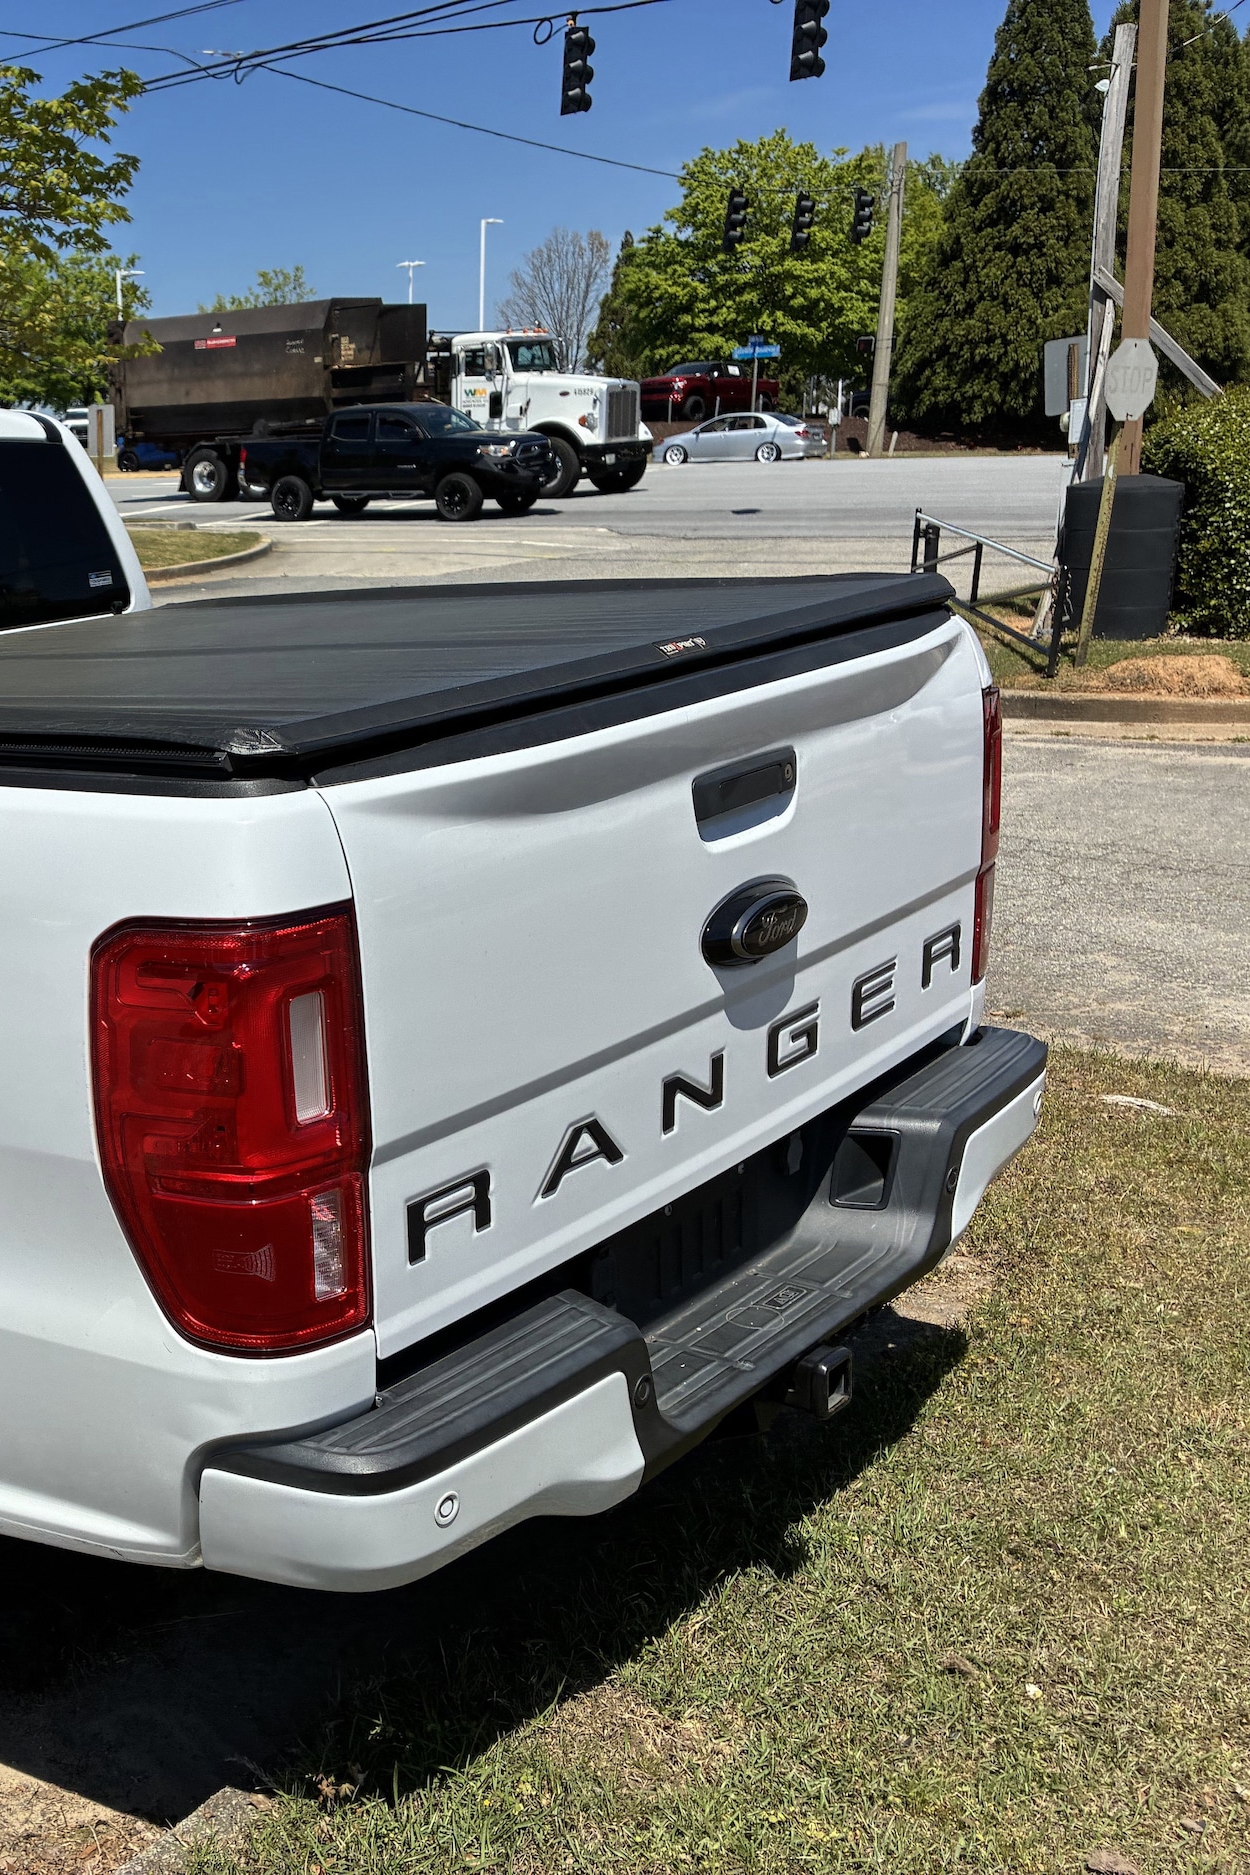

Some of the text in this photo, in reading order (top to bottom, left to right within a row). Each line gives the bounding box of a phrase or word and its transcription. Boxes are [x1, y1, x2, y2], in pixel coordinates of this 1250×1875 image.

[464, 388, 487, 397] WM
[1109, 365, 1153, 394] STOP
[759, 905, 797, 947] Ford
[406, 922, 961, 1266] RANGER
